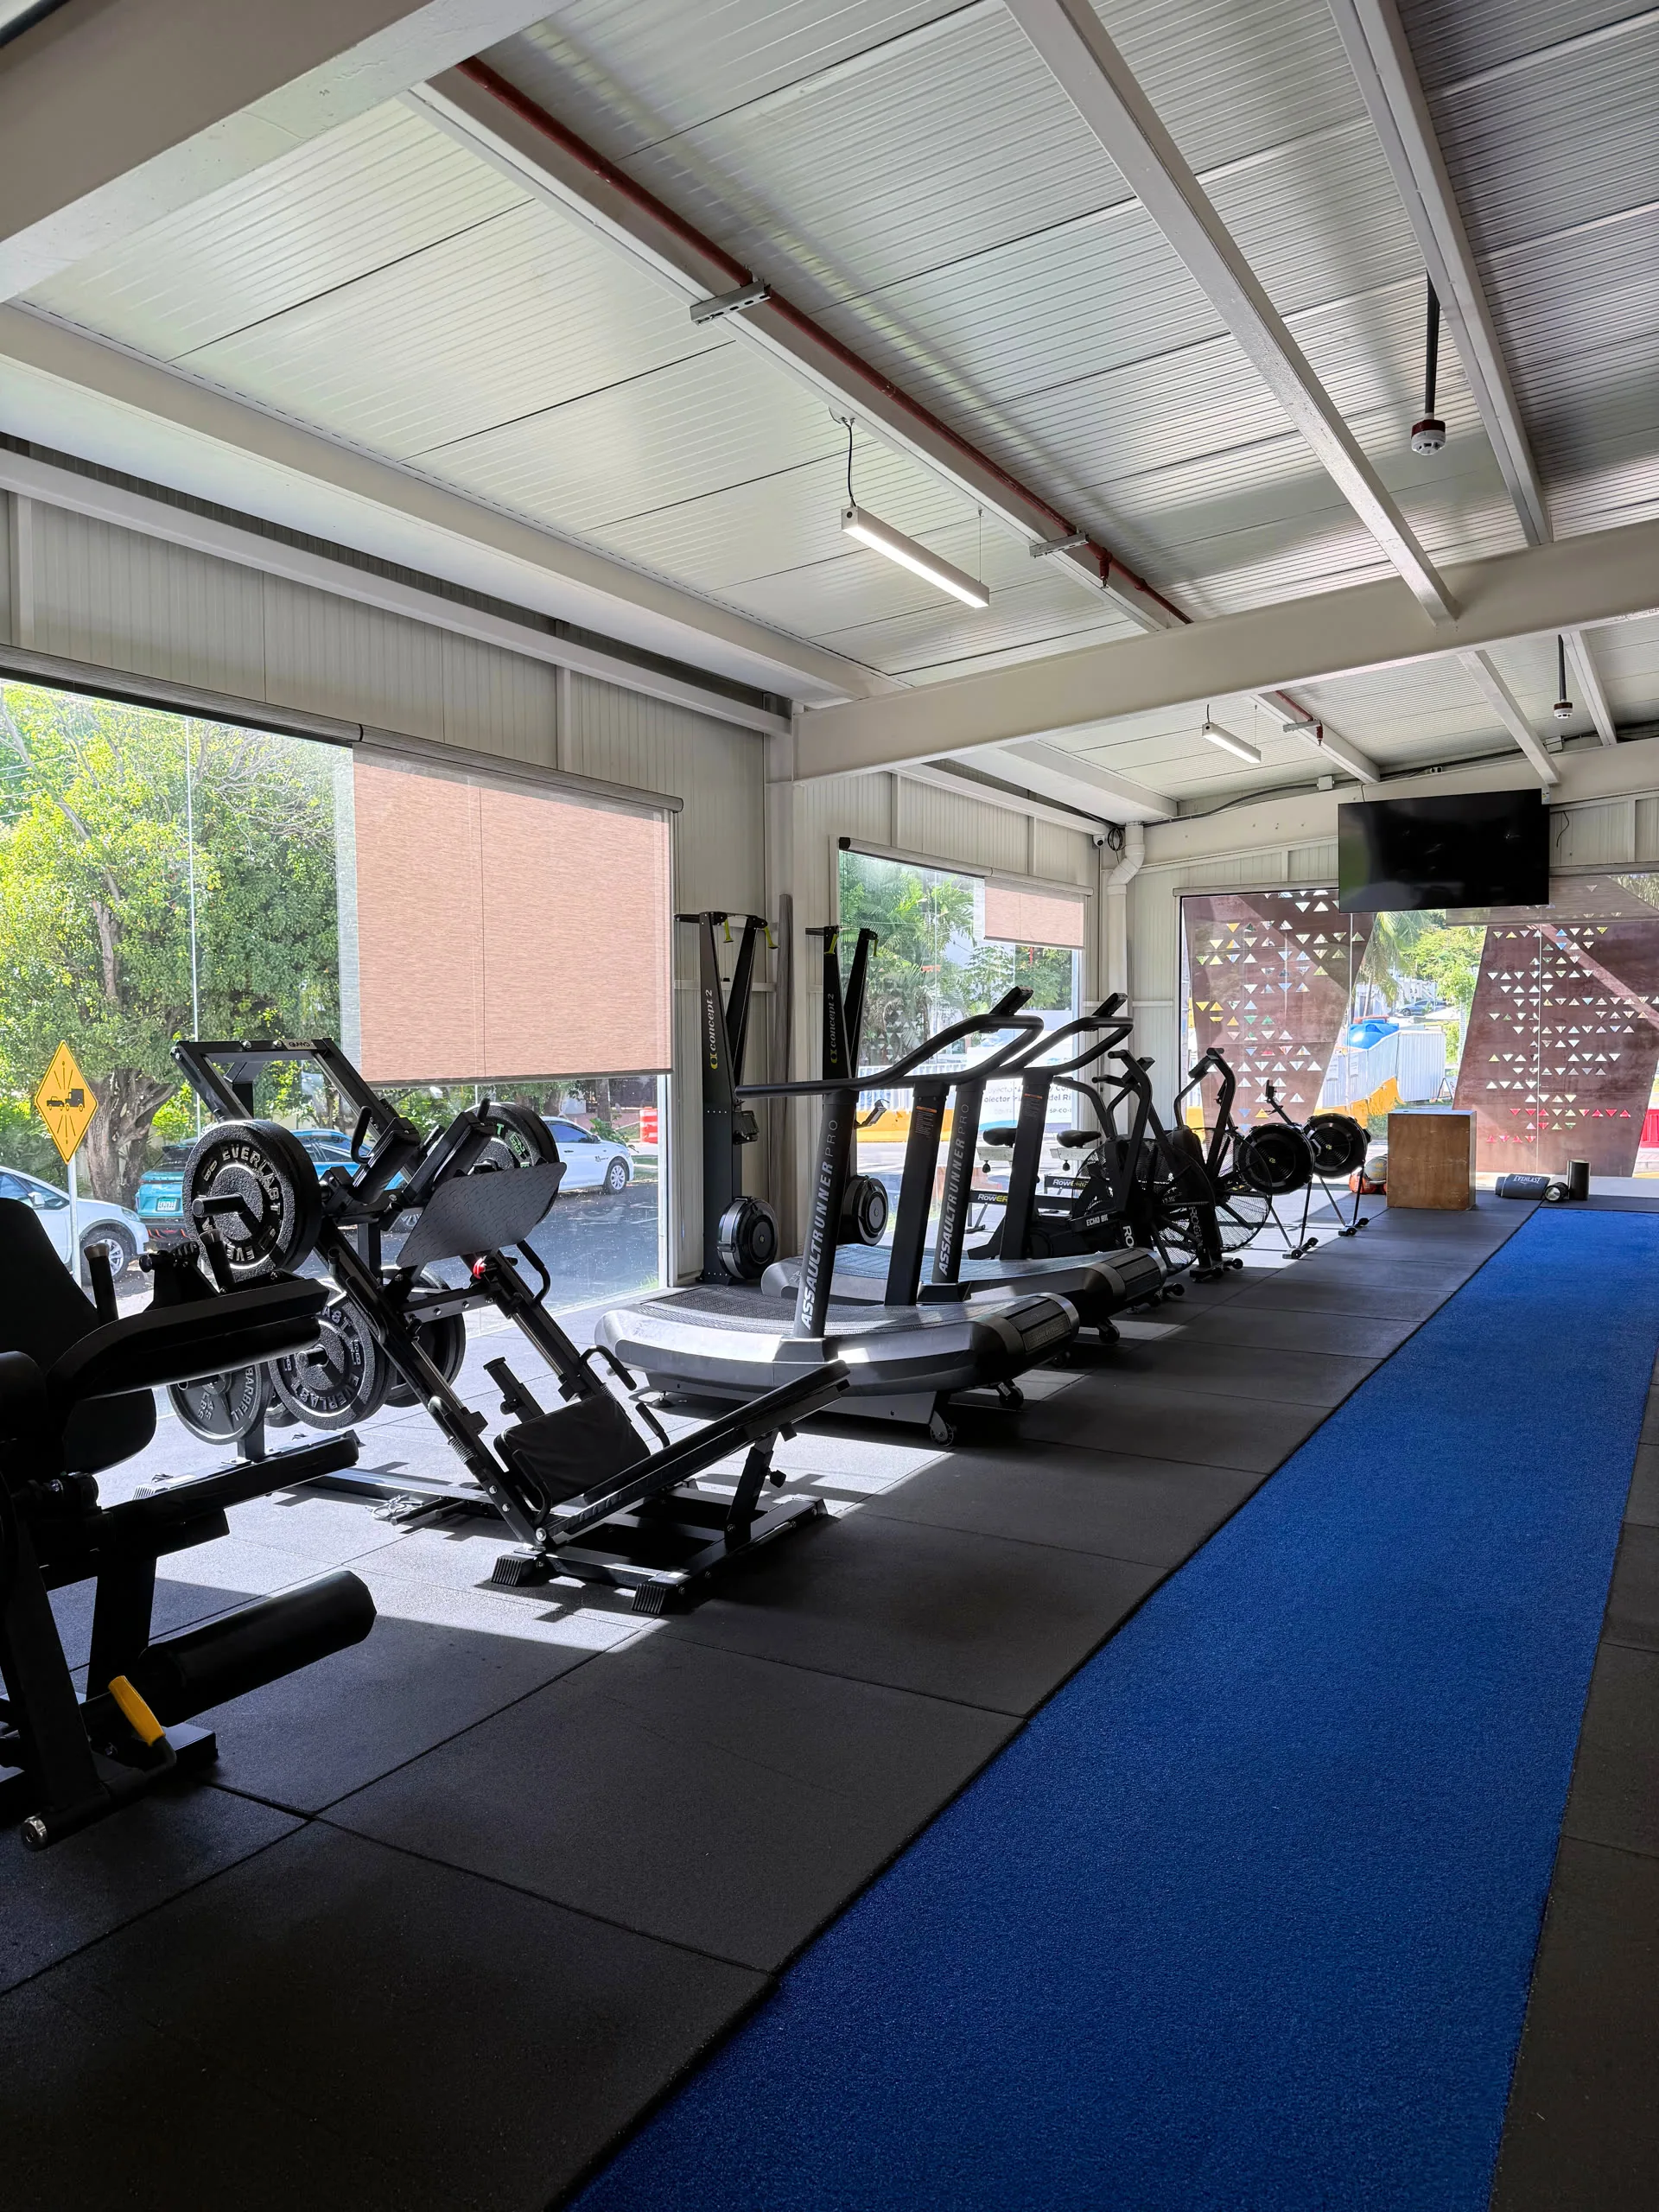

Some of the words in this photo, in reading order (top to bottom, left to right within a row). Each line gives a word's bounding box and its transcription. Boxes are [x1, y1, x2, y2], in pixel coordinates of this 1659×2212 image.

[707, 999, 716, 1052] concept
[222, 1144, 281, 1215] EVERLAST
[938, 1138, 965, 1276] ASSAULTRUNNER
[957, 1104, 969, 1135] PRO
[1513, 1175, 1542, 1184] EVERLAST
[801, 1161, 834, 1331] ASSAULTRUNNER
[825, 1120, 838, 1157] PRO
[1086, 1216, 1100, 1227] ECHO
[231, 1367, 255, 1421] BARBELL
